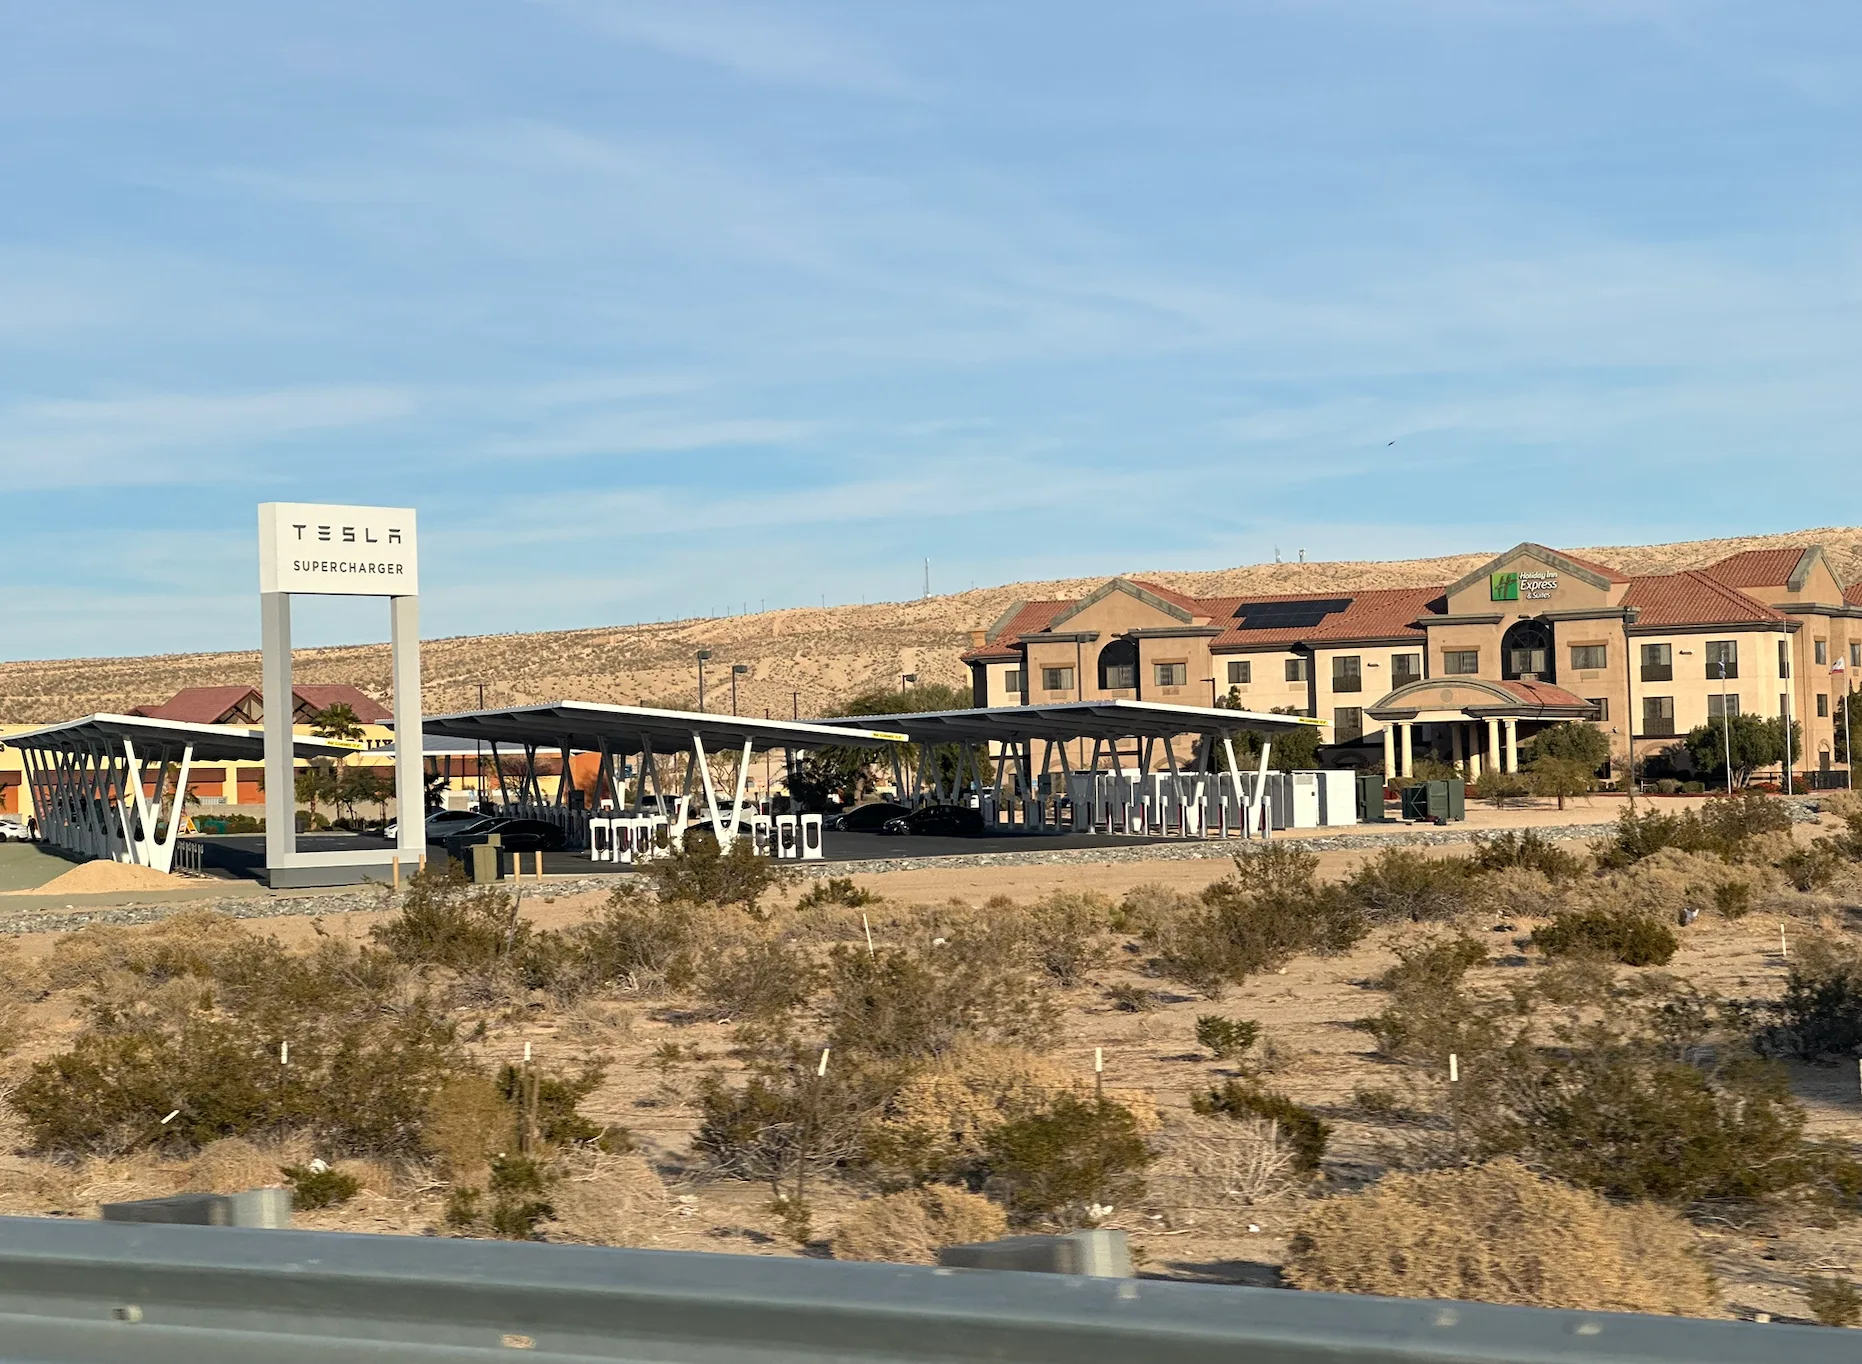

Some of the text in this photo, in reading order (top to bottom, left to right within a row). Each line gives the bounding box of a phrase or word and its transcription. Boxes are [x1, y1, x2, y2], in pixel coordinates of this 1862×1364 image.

[292, 524, 401, 544] TESLA
[293, 560, 404, 575] SUPERCHARGER
[1520, 570, 1558, 580] Holiday Inn
[1520, 579, 1558, 591] Express
[1532, 591, 1551, 599] Suites
